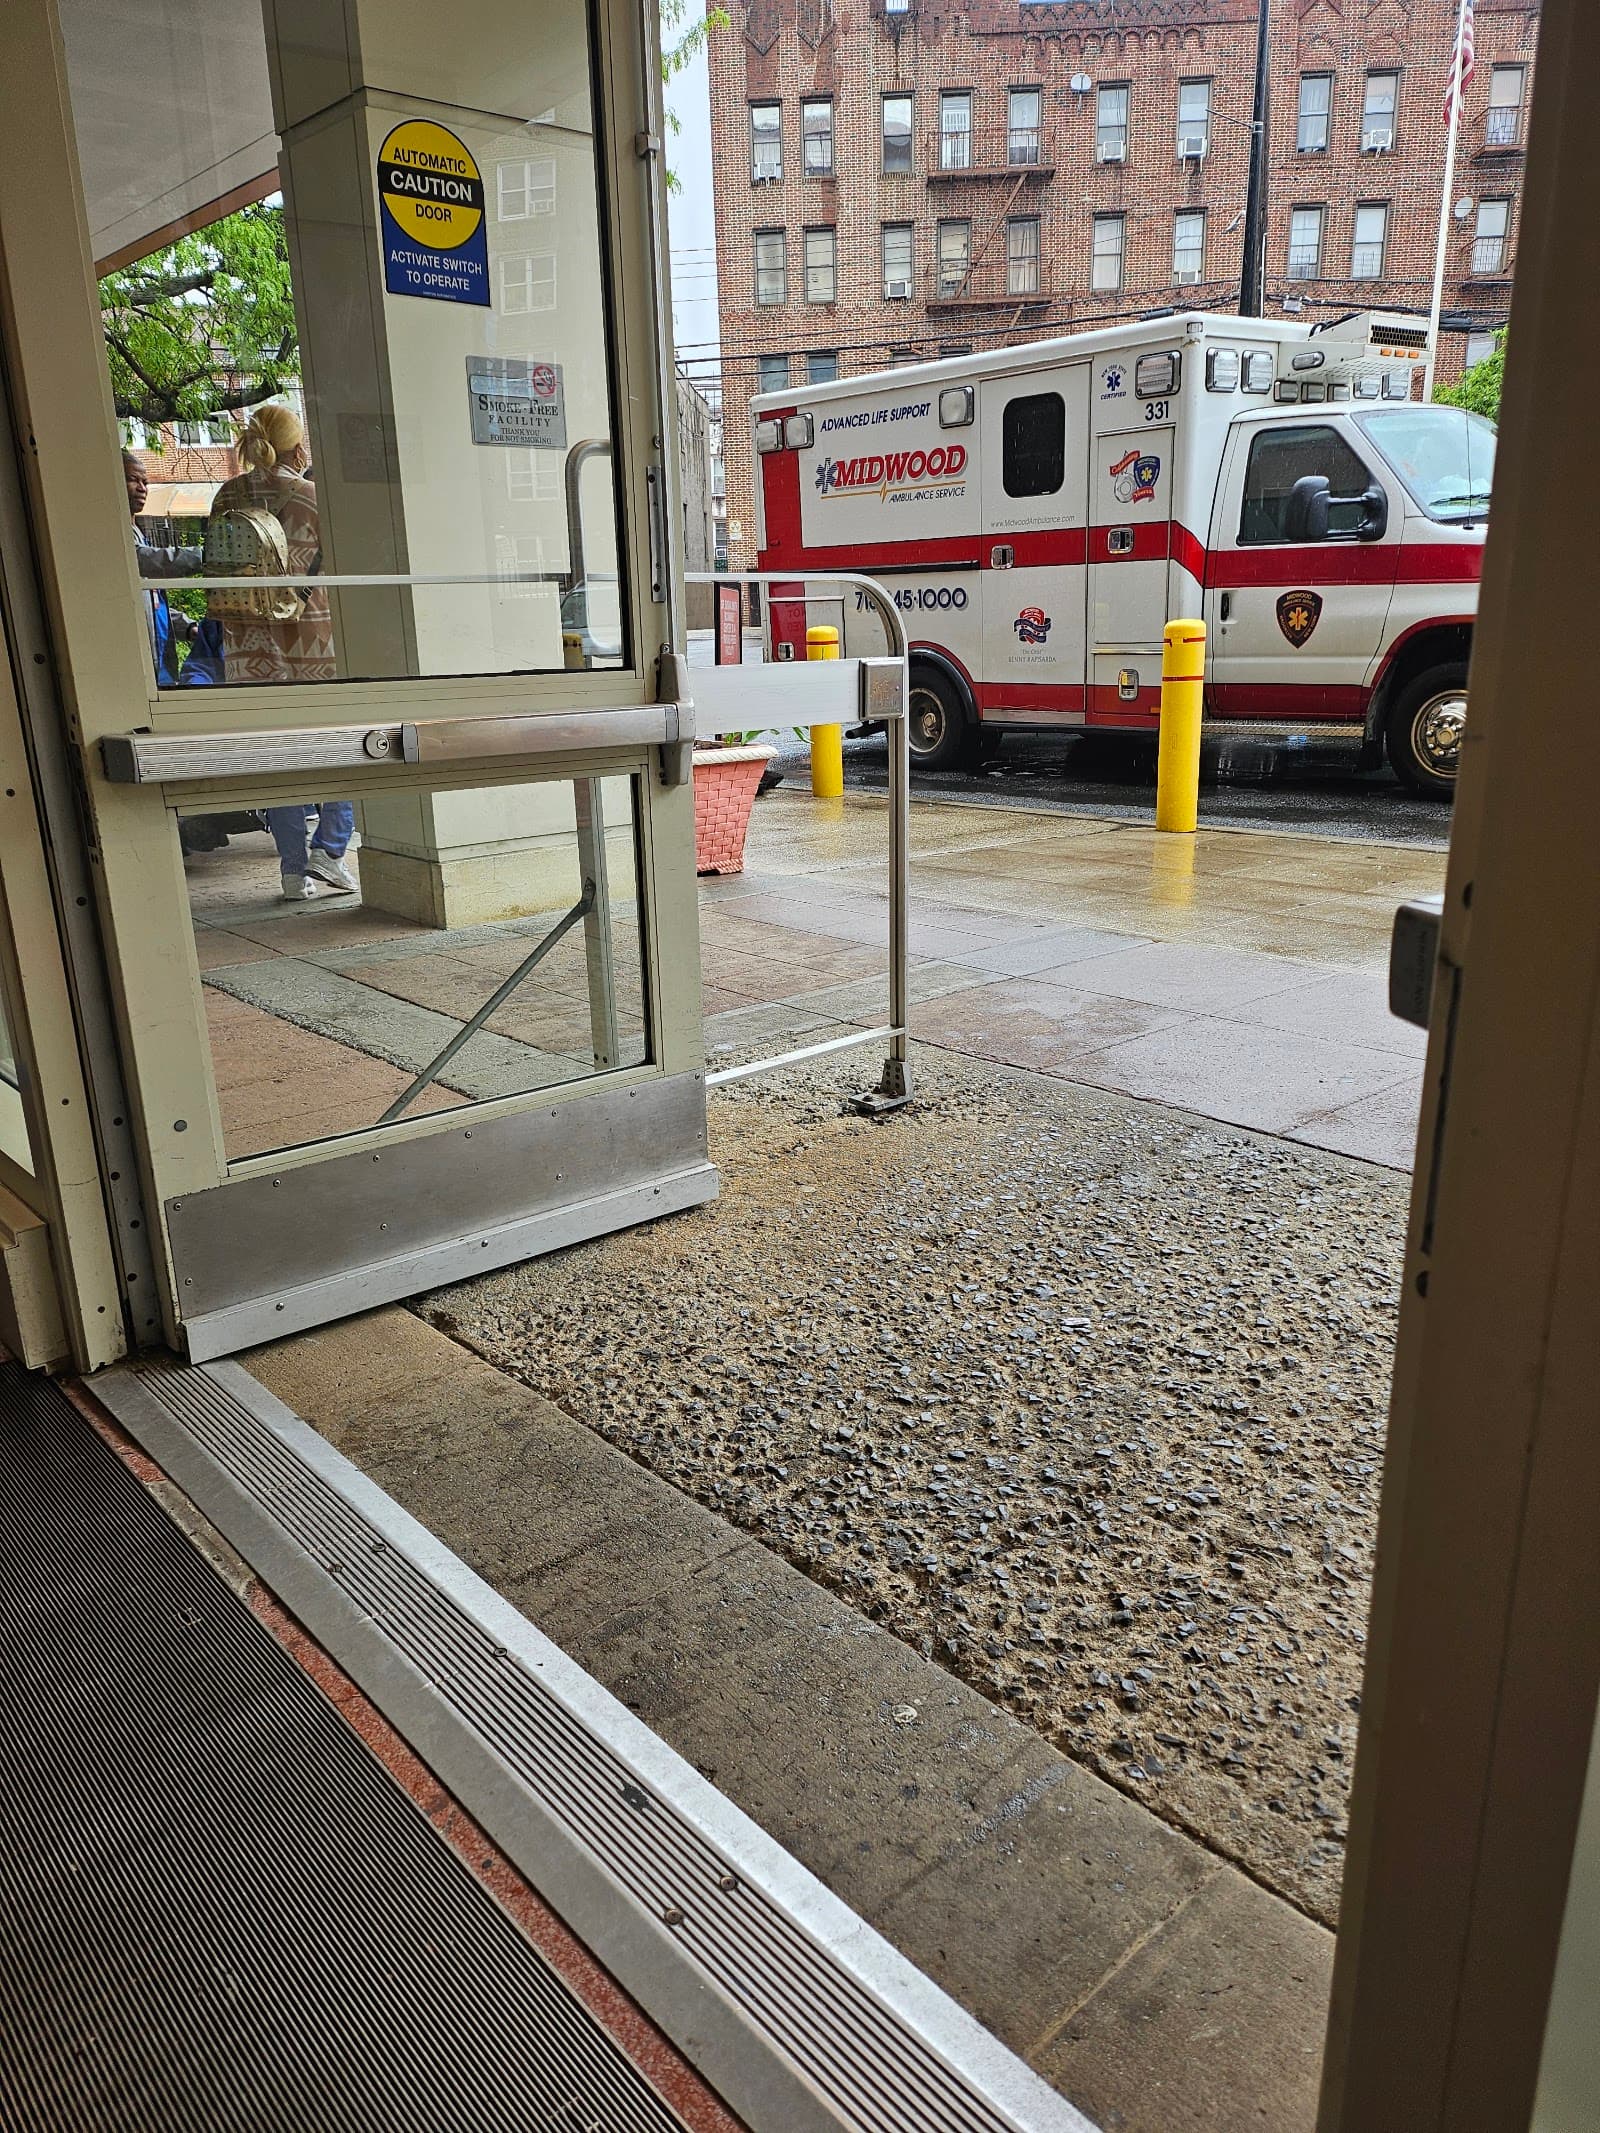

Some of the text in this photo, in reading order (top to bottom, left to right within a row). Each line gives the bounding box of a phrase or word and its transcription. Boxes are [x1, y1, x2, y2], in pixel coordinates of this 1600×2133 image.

[394, 147, 466, 174] AUTOMATIC
[390, 170, 472, 201] CAUTION
[415, 203, 452, 223] DOOR
[391, 249, 483, 275] ACTIVATE SWITCH
[406, 270, 470, 291] TO OPERATE
[1100, 391, 1127, 400] CERTIFIED
[488, 414, 551, 427] FACILITY
[820, 403, 931, 432] ADVANCED LIFE SUPPORT
[1145, 400, 1168, 421] 331
[490, 434, 552, 445] FOR NOT SMOKING
[501, 427, 541, 437] THANK YOU
[834, 445, 967, 488] MIDWOOD
[889, 487, 966, 503] AMBULANCE SERVICE
